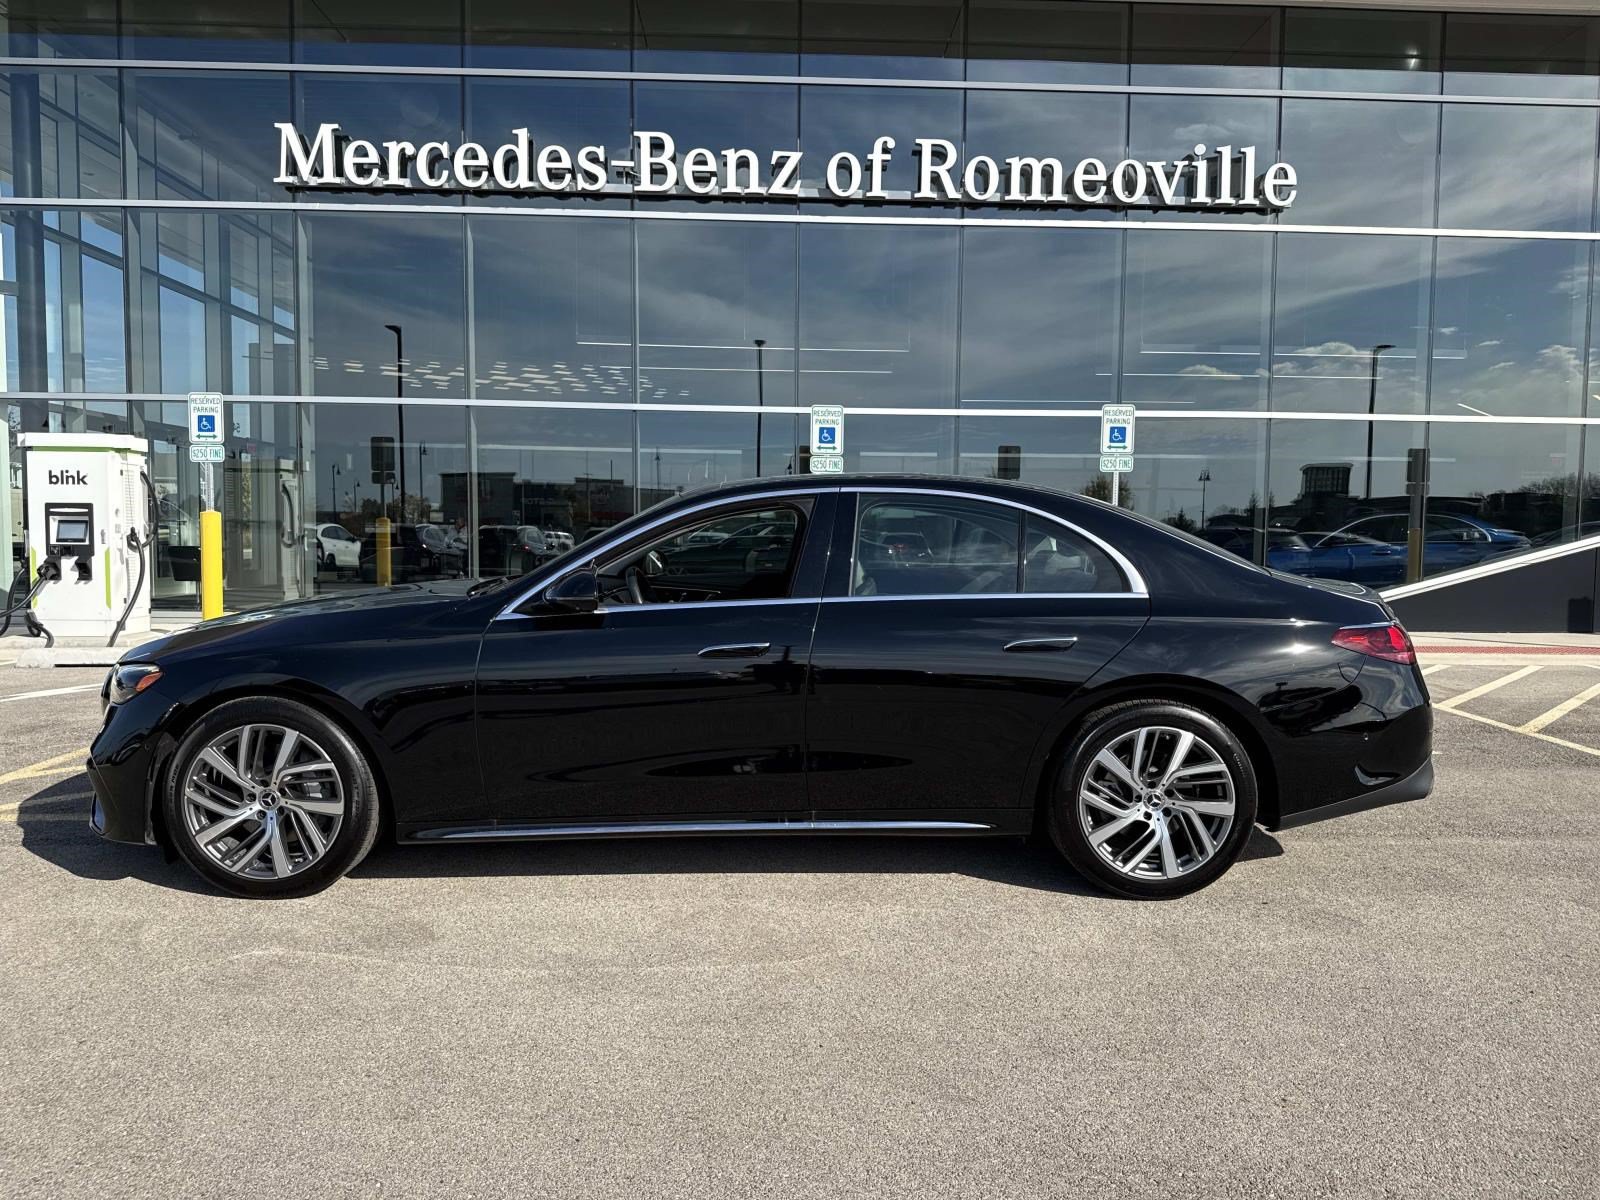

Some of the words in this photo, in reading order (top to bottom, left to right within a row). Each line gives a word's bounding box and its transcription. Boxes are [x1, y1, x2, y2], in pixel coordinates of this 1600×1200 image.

[273, 122, 801, 197] Mercedes-Benz
[826, 136, 896, 198] of
[914, 138, 1298, 207] Romeoville
[190, 397, 221, 405] RESERVED
[193, 406, 219, 414] PARKING
[813, 409, 842, 418] RESERVED
[1104, 409, 1132, 417] RESERVED
[815, 418, 840, 426] PARKING
[1105, 417, 1131, 425] PARKING
[48, 469, 88, 486] blink
